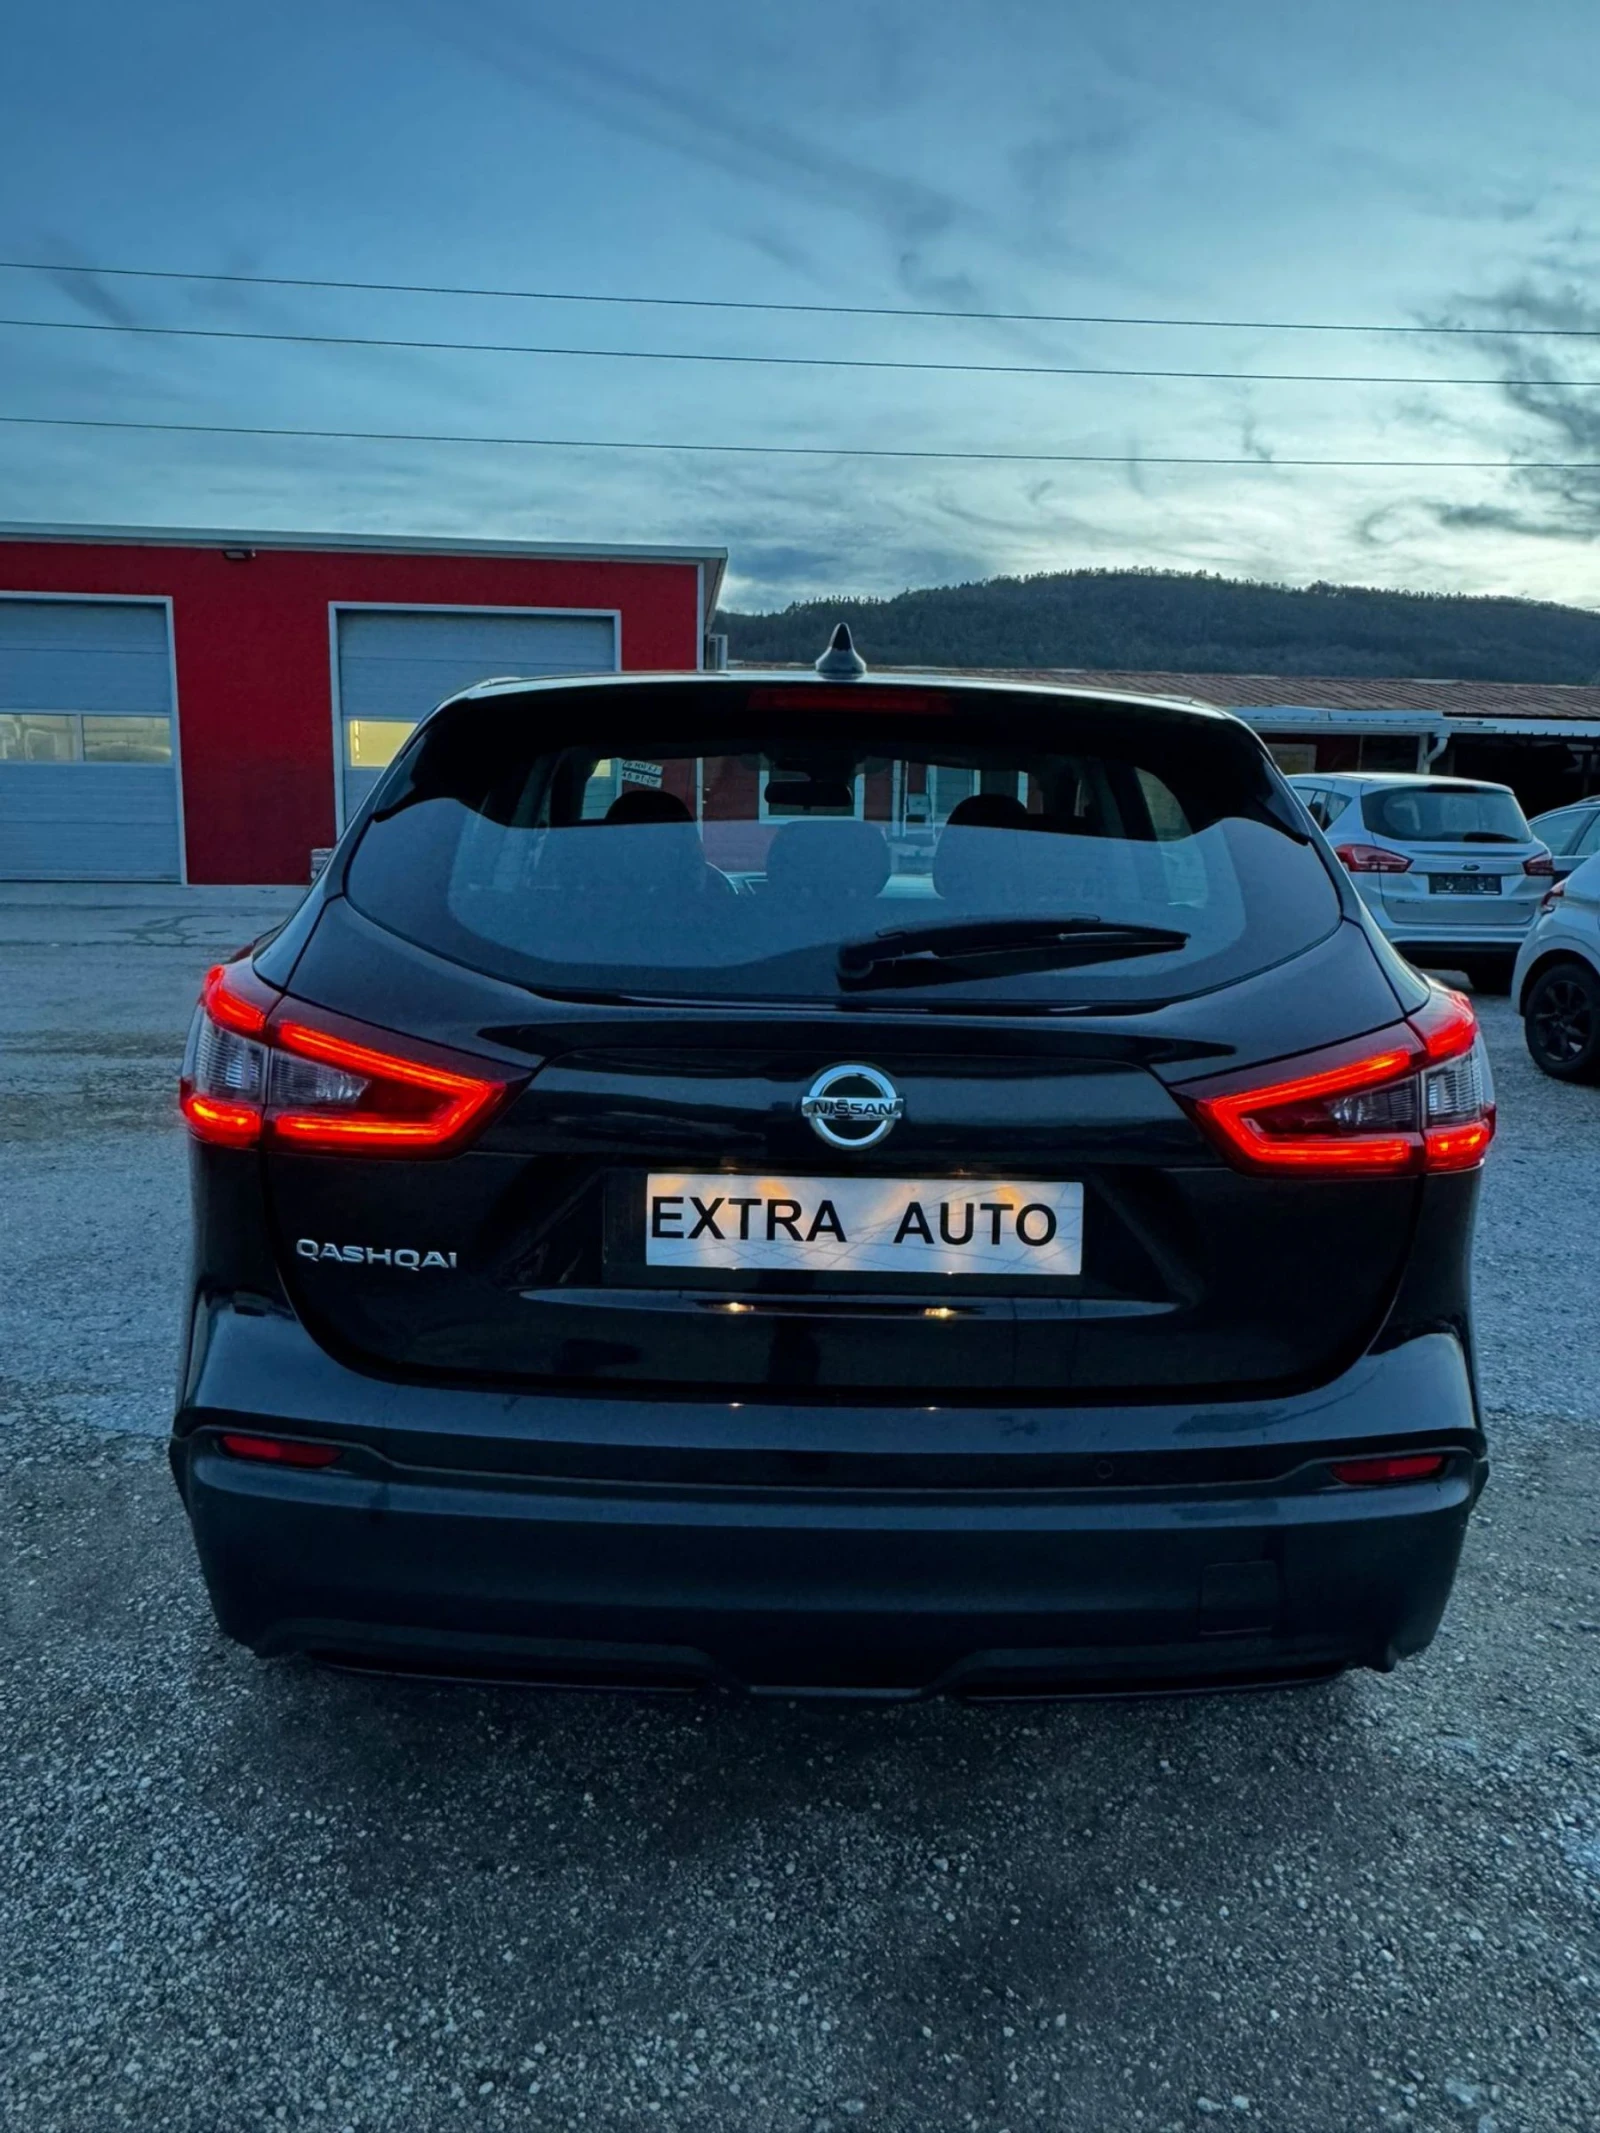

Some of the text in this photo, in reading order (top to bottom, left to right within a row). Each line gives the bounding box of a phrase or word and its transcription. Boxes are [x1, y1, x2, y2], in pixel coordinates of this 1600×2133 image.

[812, 1100, 893, 1115] NISSAN
[651, 1196, 1058, 1246] EXTRA AUTO
[296, 1238, 457, 1272] QASHQAI
